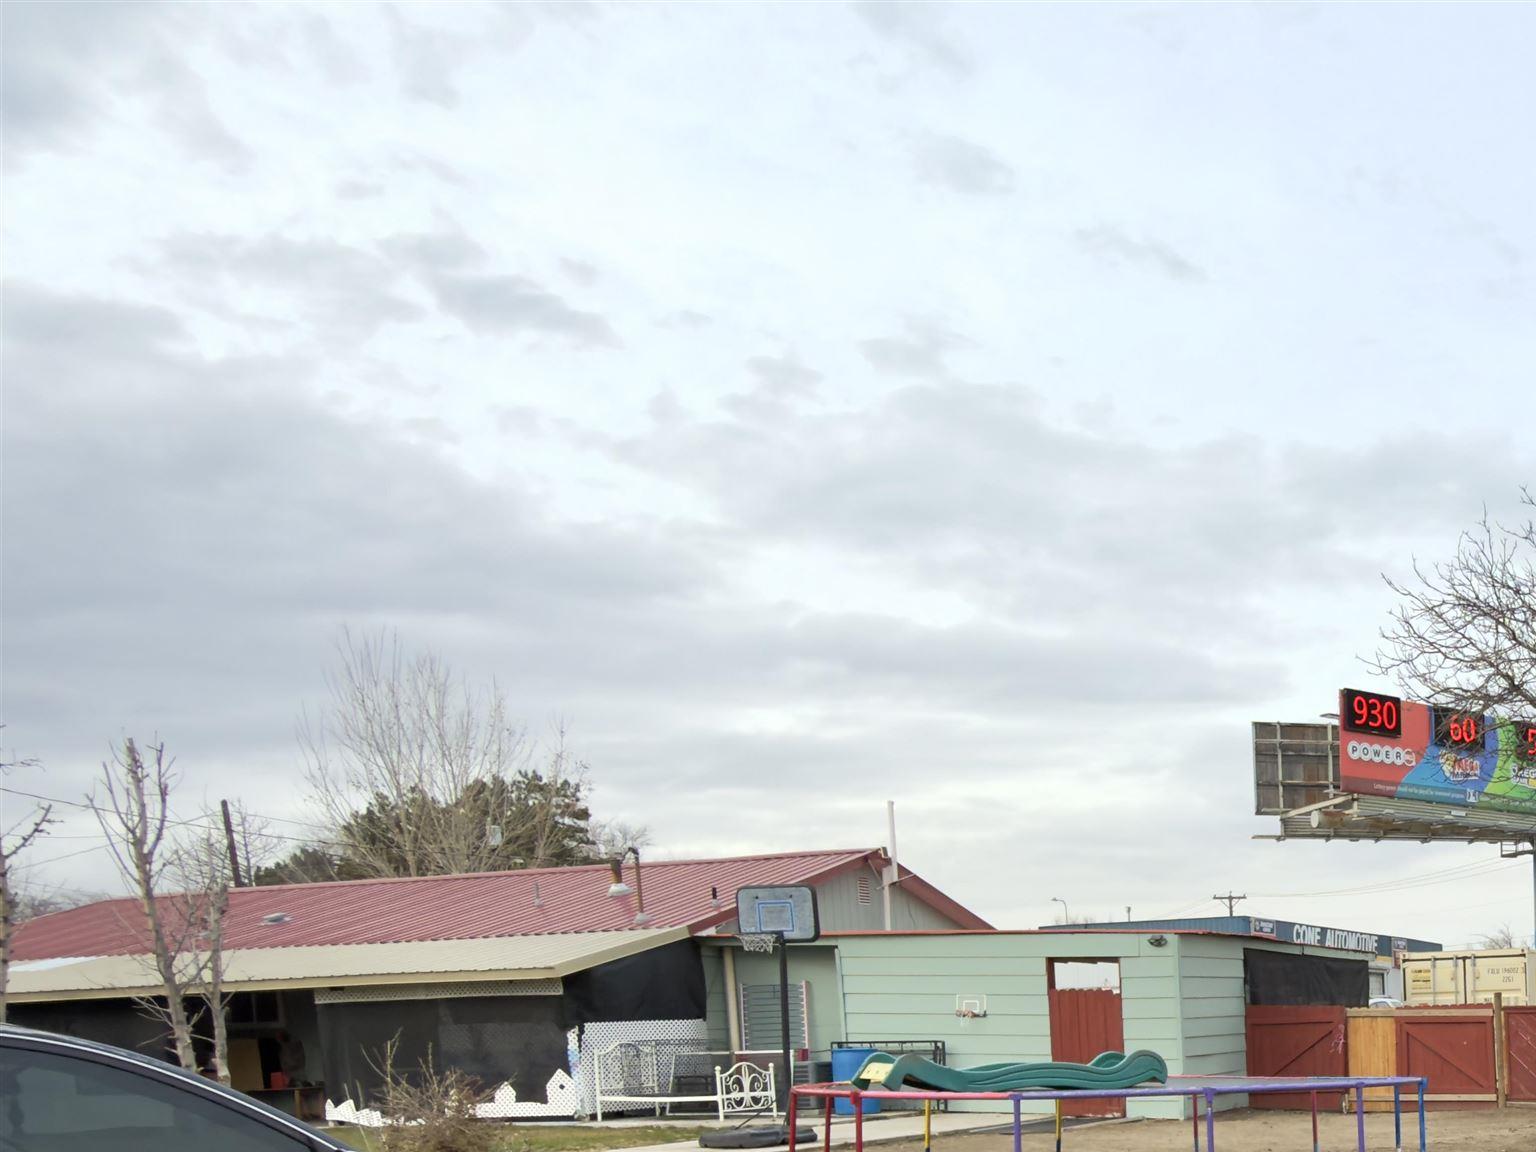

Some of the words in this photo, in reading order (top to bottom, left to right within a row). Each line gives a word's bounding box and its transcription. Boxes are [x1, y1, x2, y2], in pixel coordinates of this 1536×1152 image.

[1353, 695, 1397, 730] 930
[1450, 714, 1477, 743] 60
[1350, 743, 1403, 763] POWER
[1293, 924, 1321, 945] CONE
[1325, 929, 1378, 952] AUTOMOTIVE
